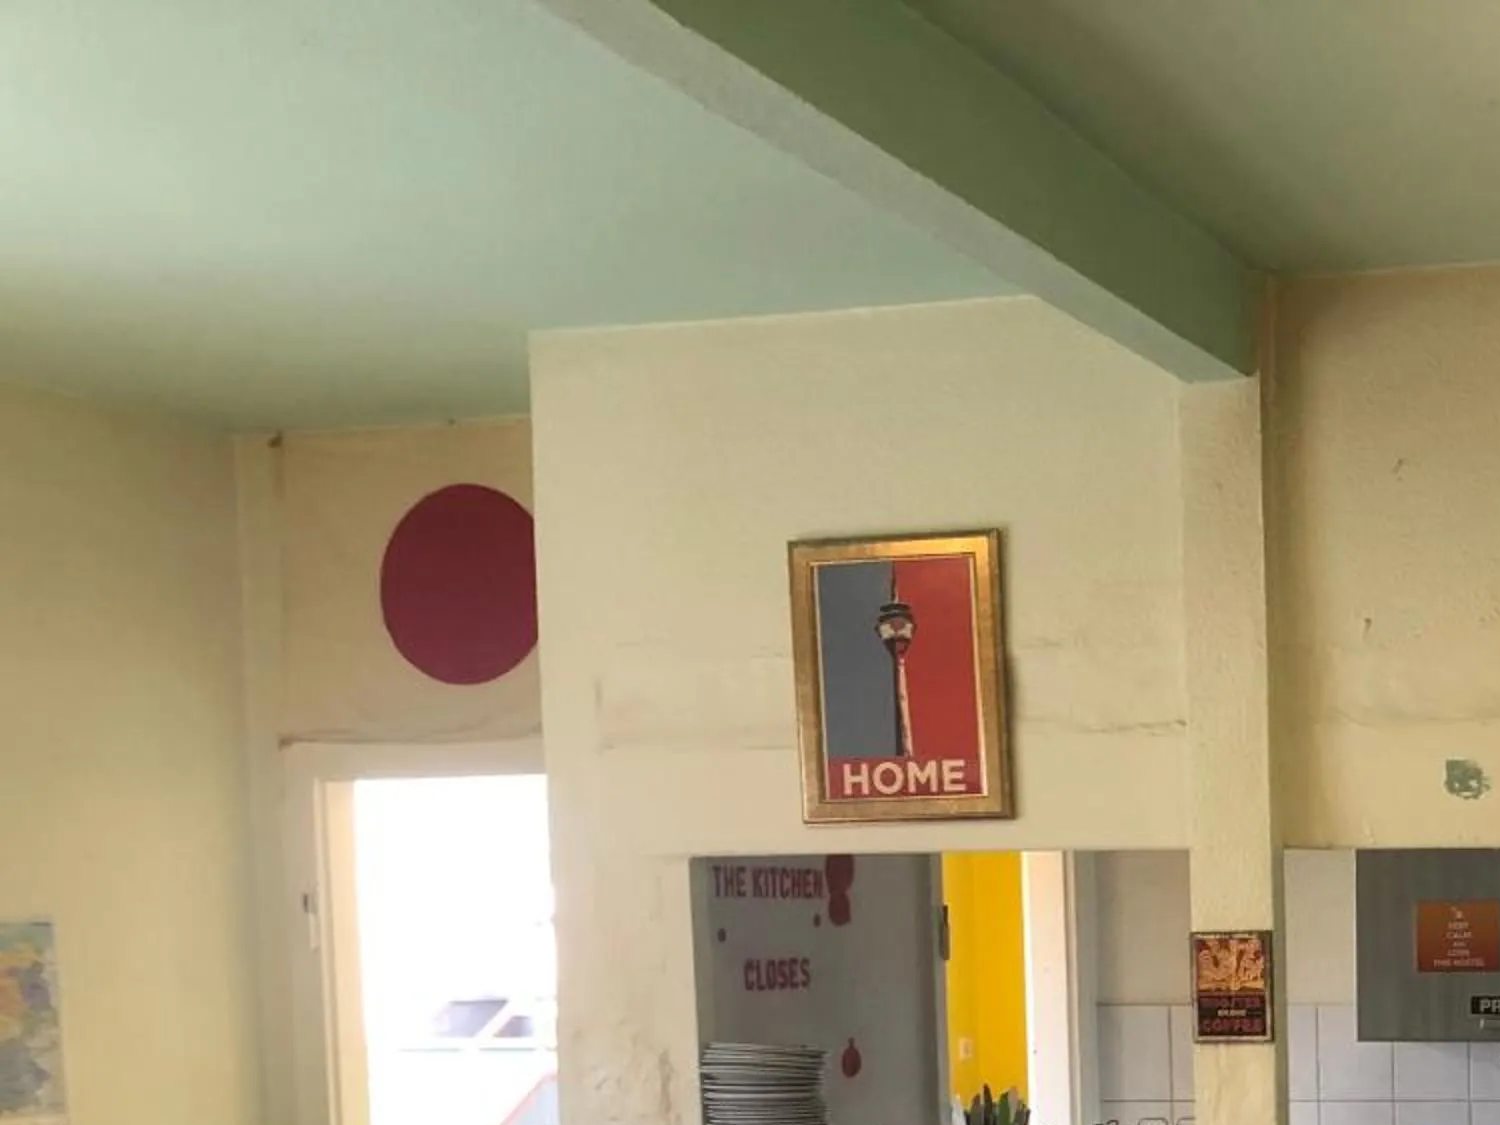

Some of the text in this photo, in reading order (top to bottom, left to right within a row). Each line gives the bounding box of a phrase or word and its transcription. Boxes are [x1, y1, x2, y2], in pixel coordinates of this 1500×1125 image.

[842, 759, 967, 796] HOME
[712, 865, 823, 900] THE KITCHEN
[743, 957, 812, 992] CLOSES
